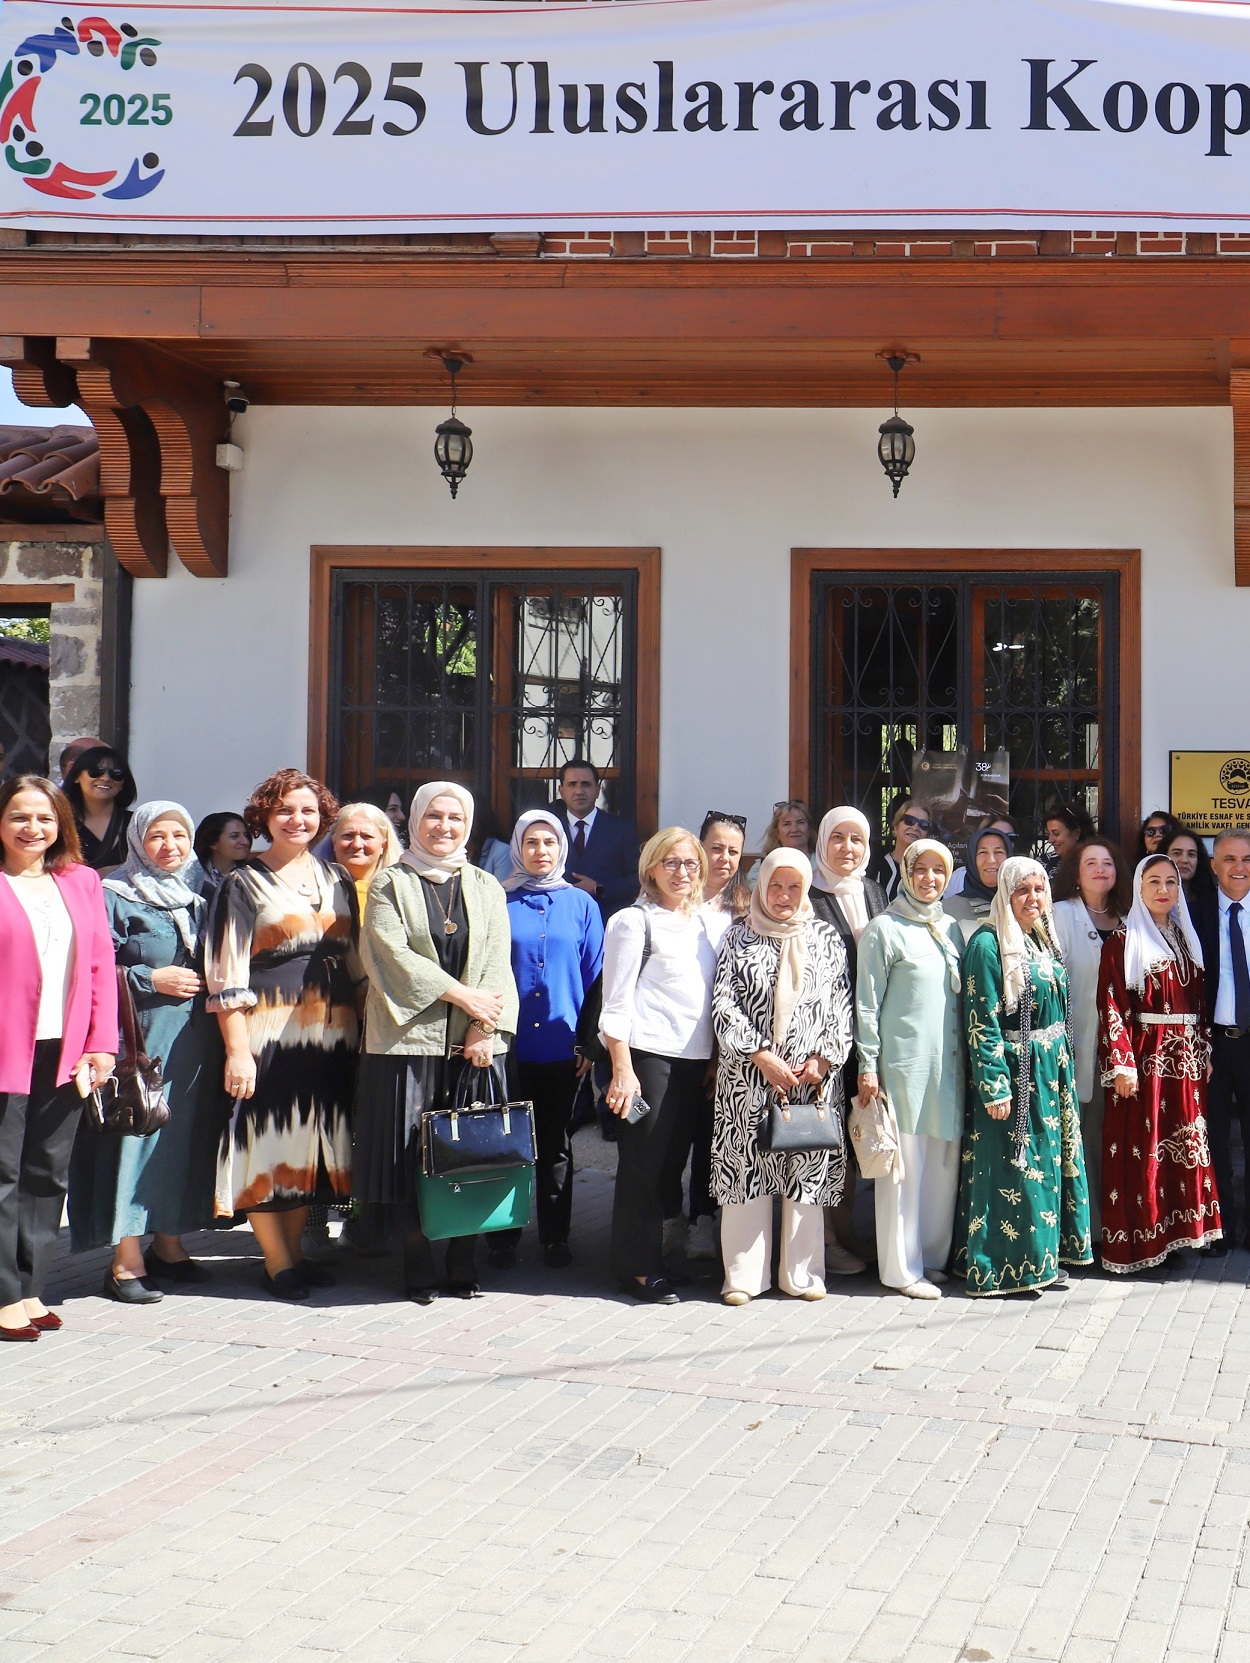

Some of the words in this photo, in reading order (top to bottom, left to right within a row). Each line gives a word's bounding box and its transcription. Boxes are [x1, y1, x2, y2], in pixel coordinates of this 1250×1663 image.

[232, 62, 427, 137] 2025
[455, 60, 992, 136] Uluslararası
[80, 93, 173, 126] 2025
[1177, 811, 1208, 820] TÜRKİYE
[1186, 821, 1210, 829] AHİLİK
